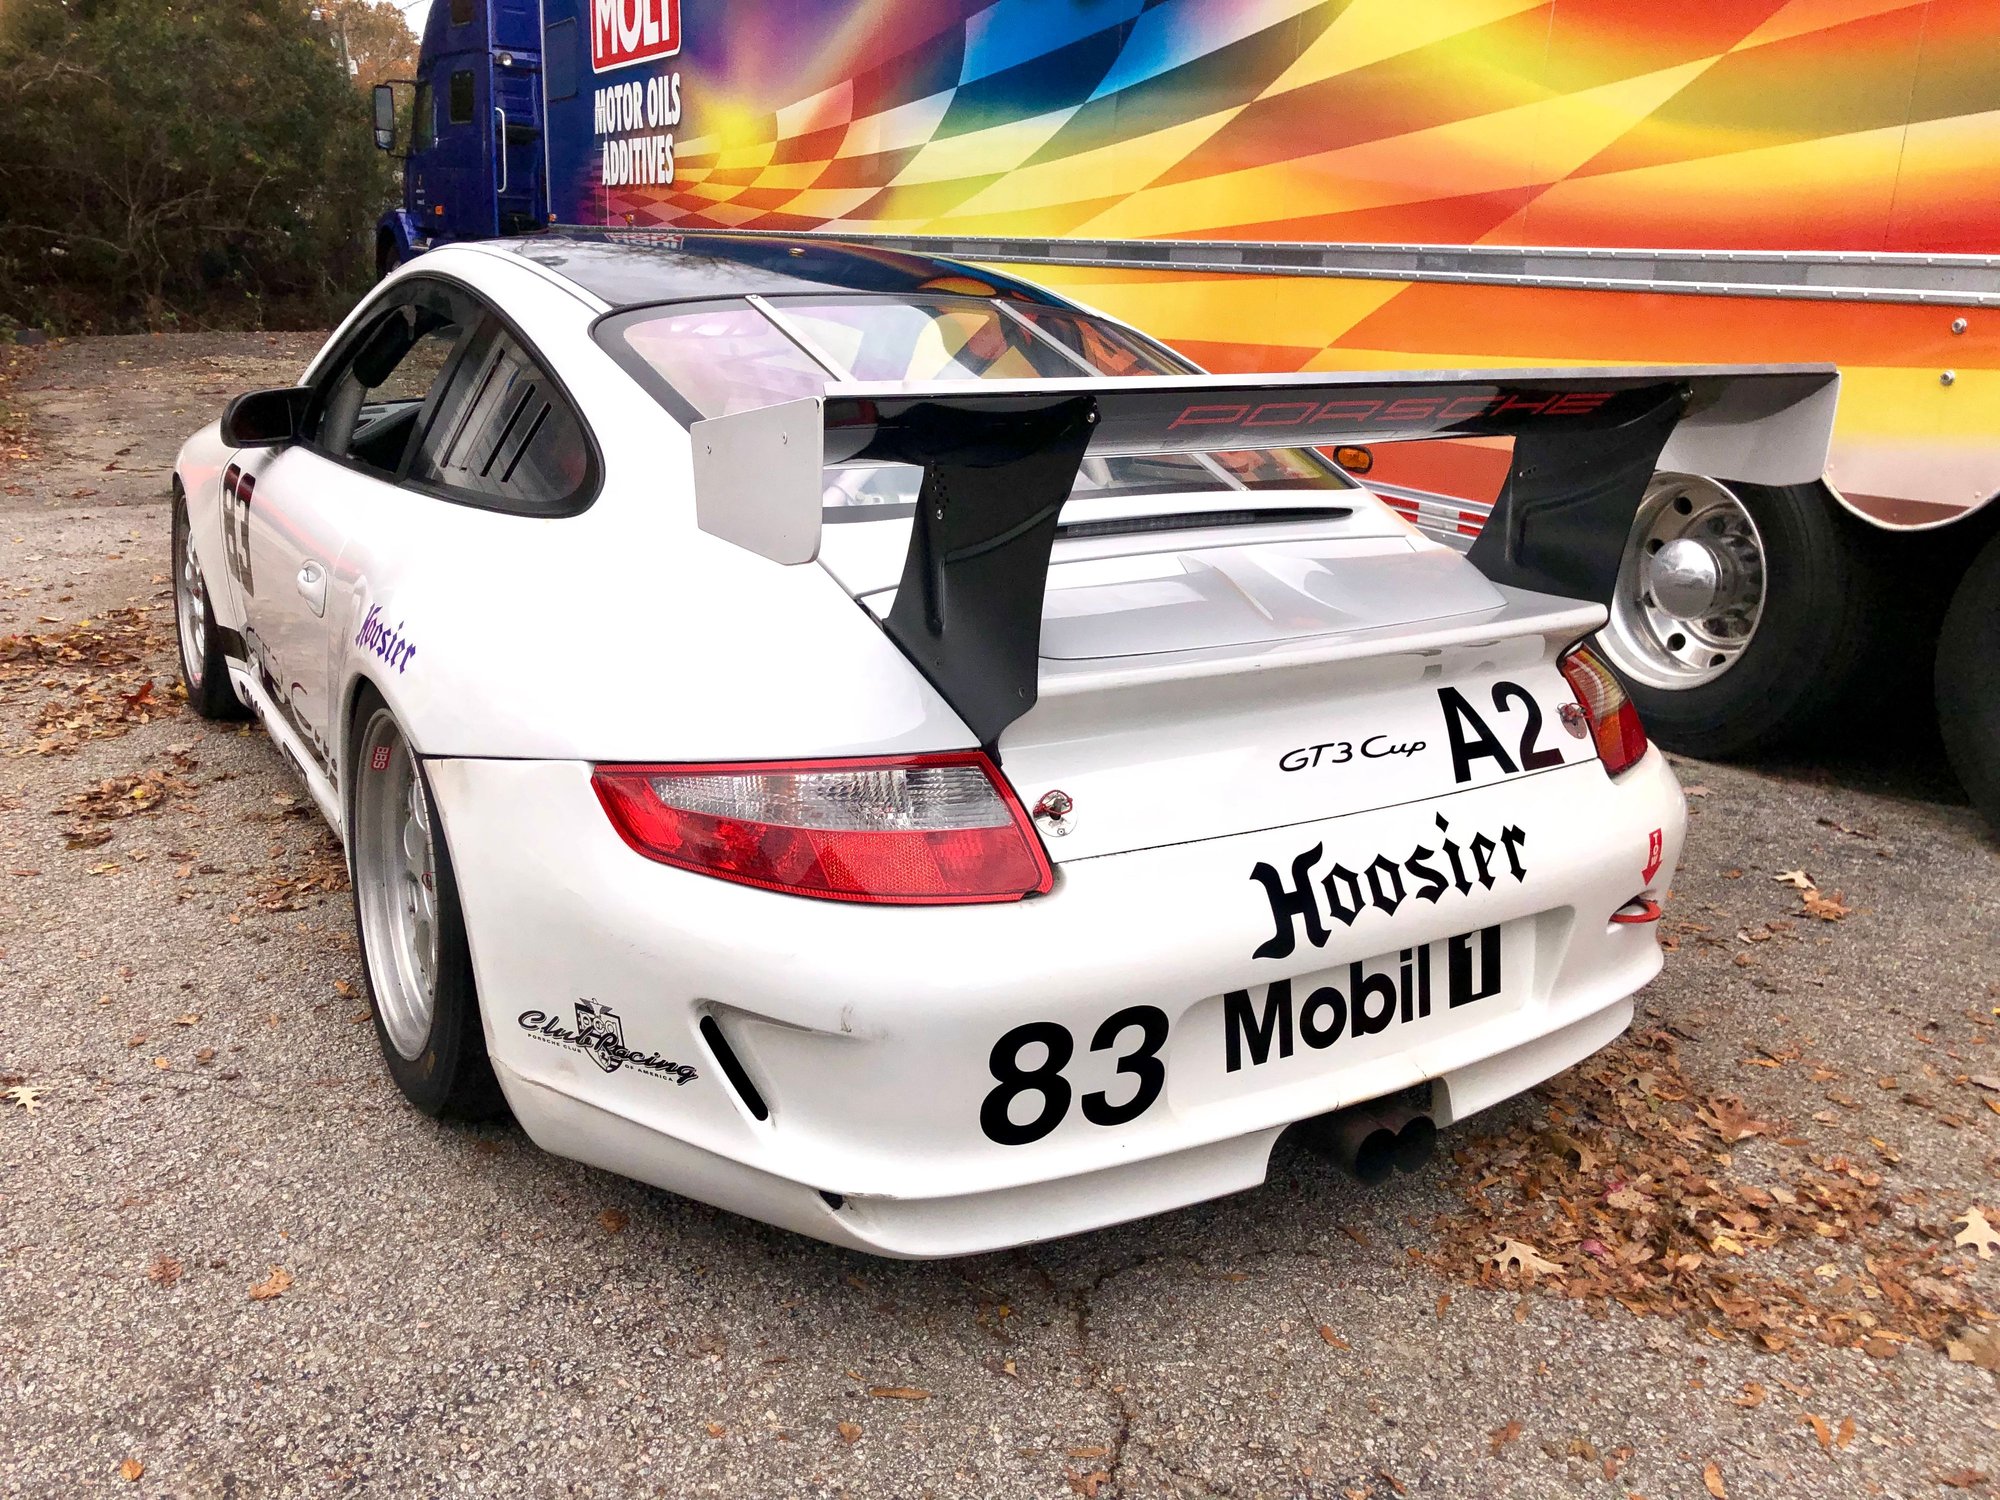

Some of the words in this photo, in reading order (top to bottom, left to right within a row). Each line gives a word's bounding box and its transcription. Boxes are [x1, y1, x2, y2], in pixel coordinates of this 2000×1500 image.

[595, 81, 643, 135] MOTOR
[647, 72, 681, 128] OILS
[602, 133, 674, 186] ADDITIVES
[1167, 393, 1612, 430] PORSCHE
[355, 603, 416, 674] Hoosier
[373, 746, 390, 770] BBS
[1279, 742, 1353, 772] GT3
[1360, 735, 1427, 758] Cup
[1437, 681, 1565, 784] A2
[1650, 832, 1659, 867] TOW
[1249, 811, 1527, 960] Hoosier
[1223, 943, 1430, 1073] Mobil
[518, 1010, 595, 1048] Club
[594, 1032, 699, 1086] Racing
[527, 1033, 561, 1048] PORSCHE
[563, 1044, 582, 1054] CLUB
[624, 1063, 634, 1071] OF
[637, 1066, 674, 1082] AMERICA
[979, 1004, 1170, 1147] 83
